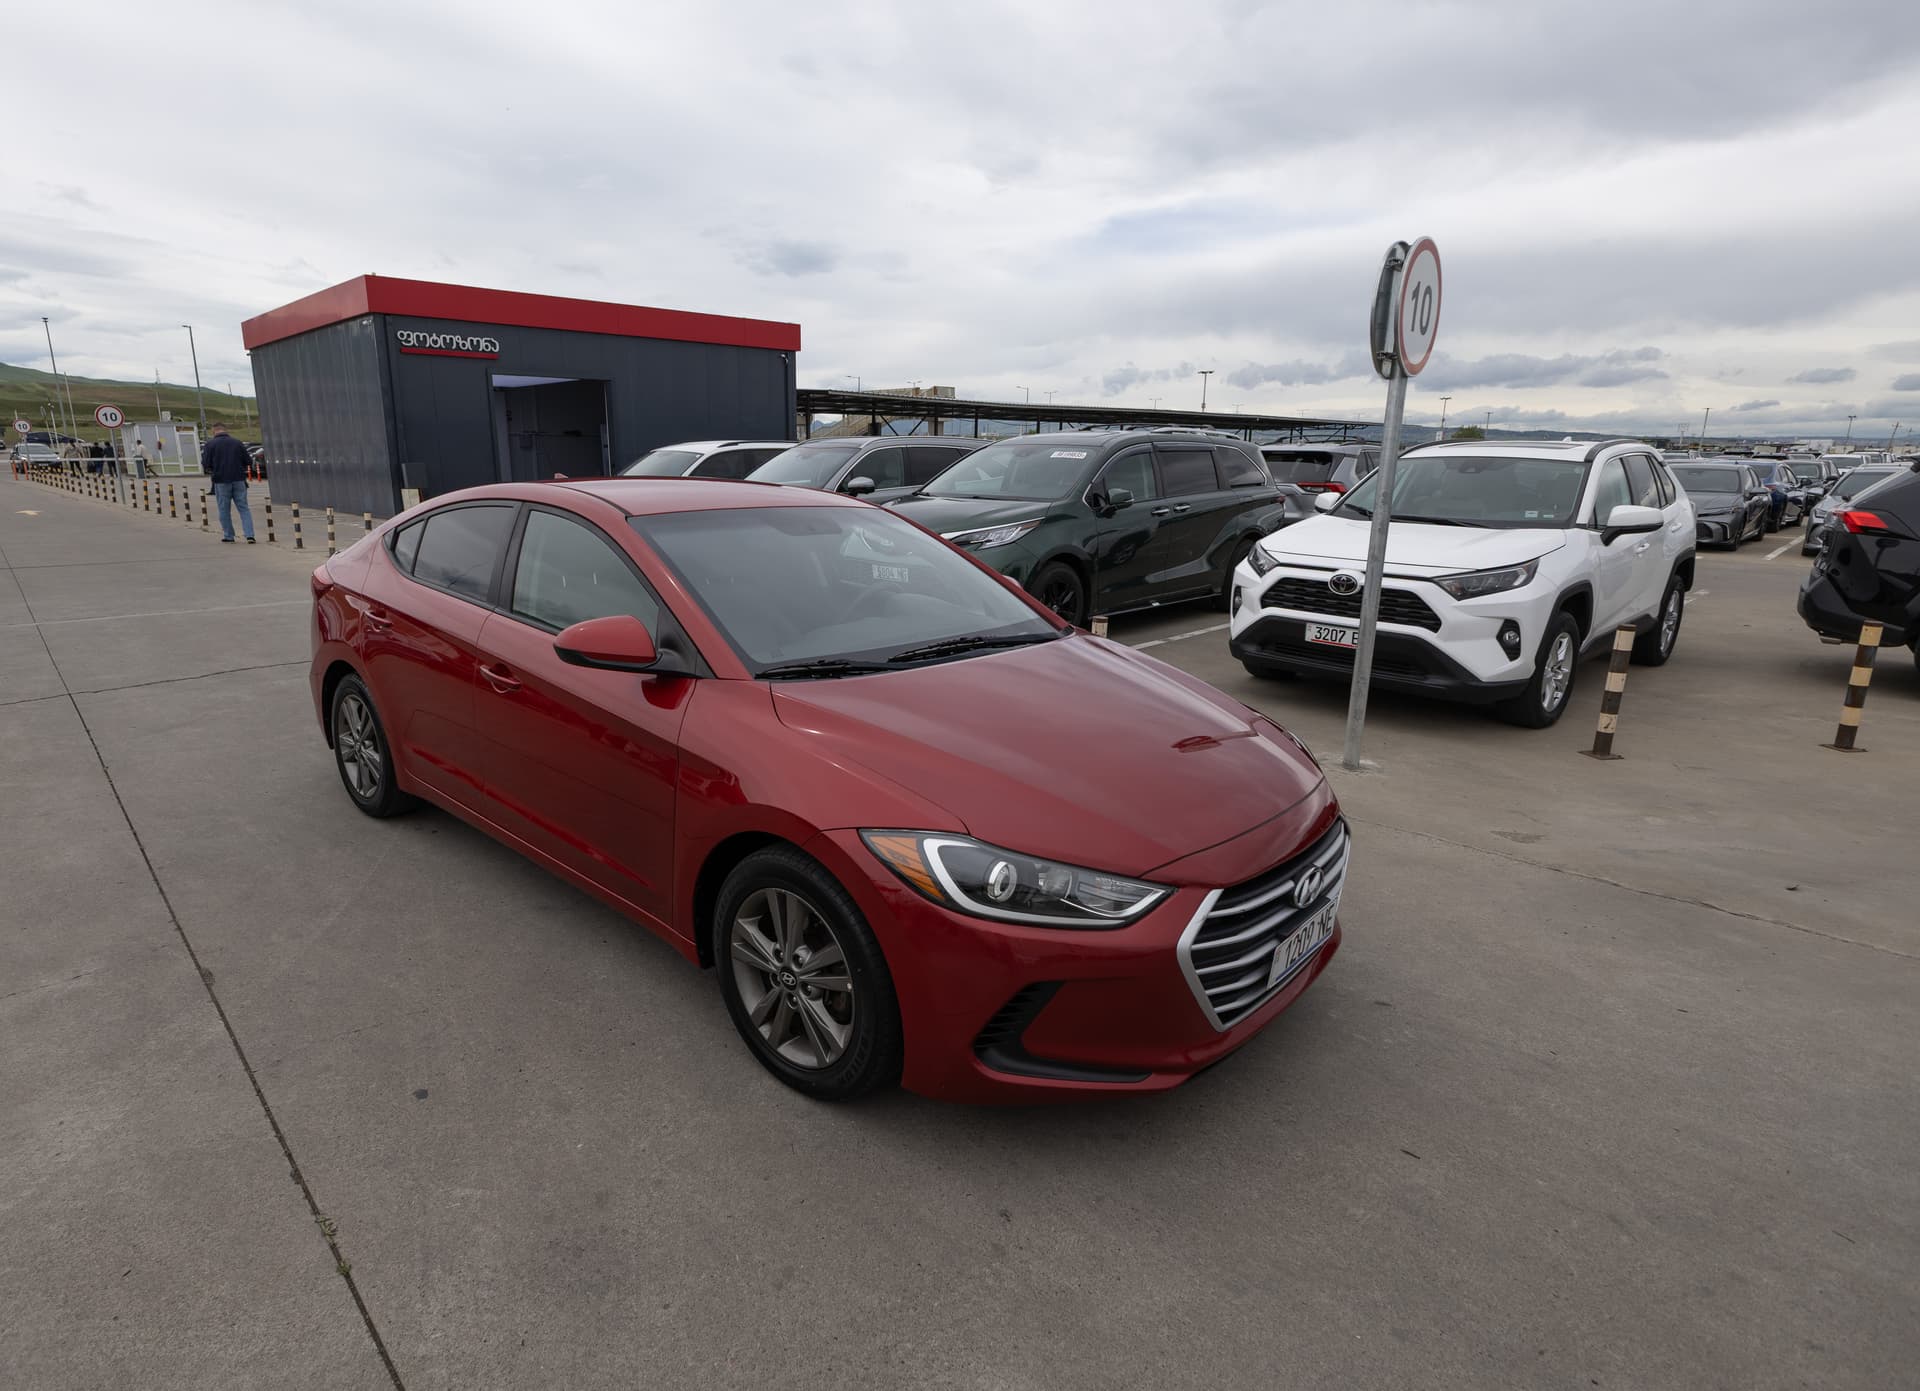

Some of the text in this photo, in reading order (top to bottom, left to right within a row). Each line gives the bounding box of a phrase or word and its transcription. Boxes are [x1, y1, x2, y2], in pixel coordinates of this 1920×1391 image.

[1411, 281, 1432, 335] 10
[397, 330, 499, 352] ფოტოზონა
[102, 412, 117, 422] 10
[1315, 626, 1346, 643] 3207
